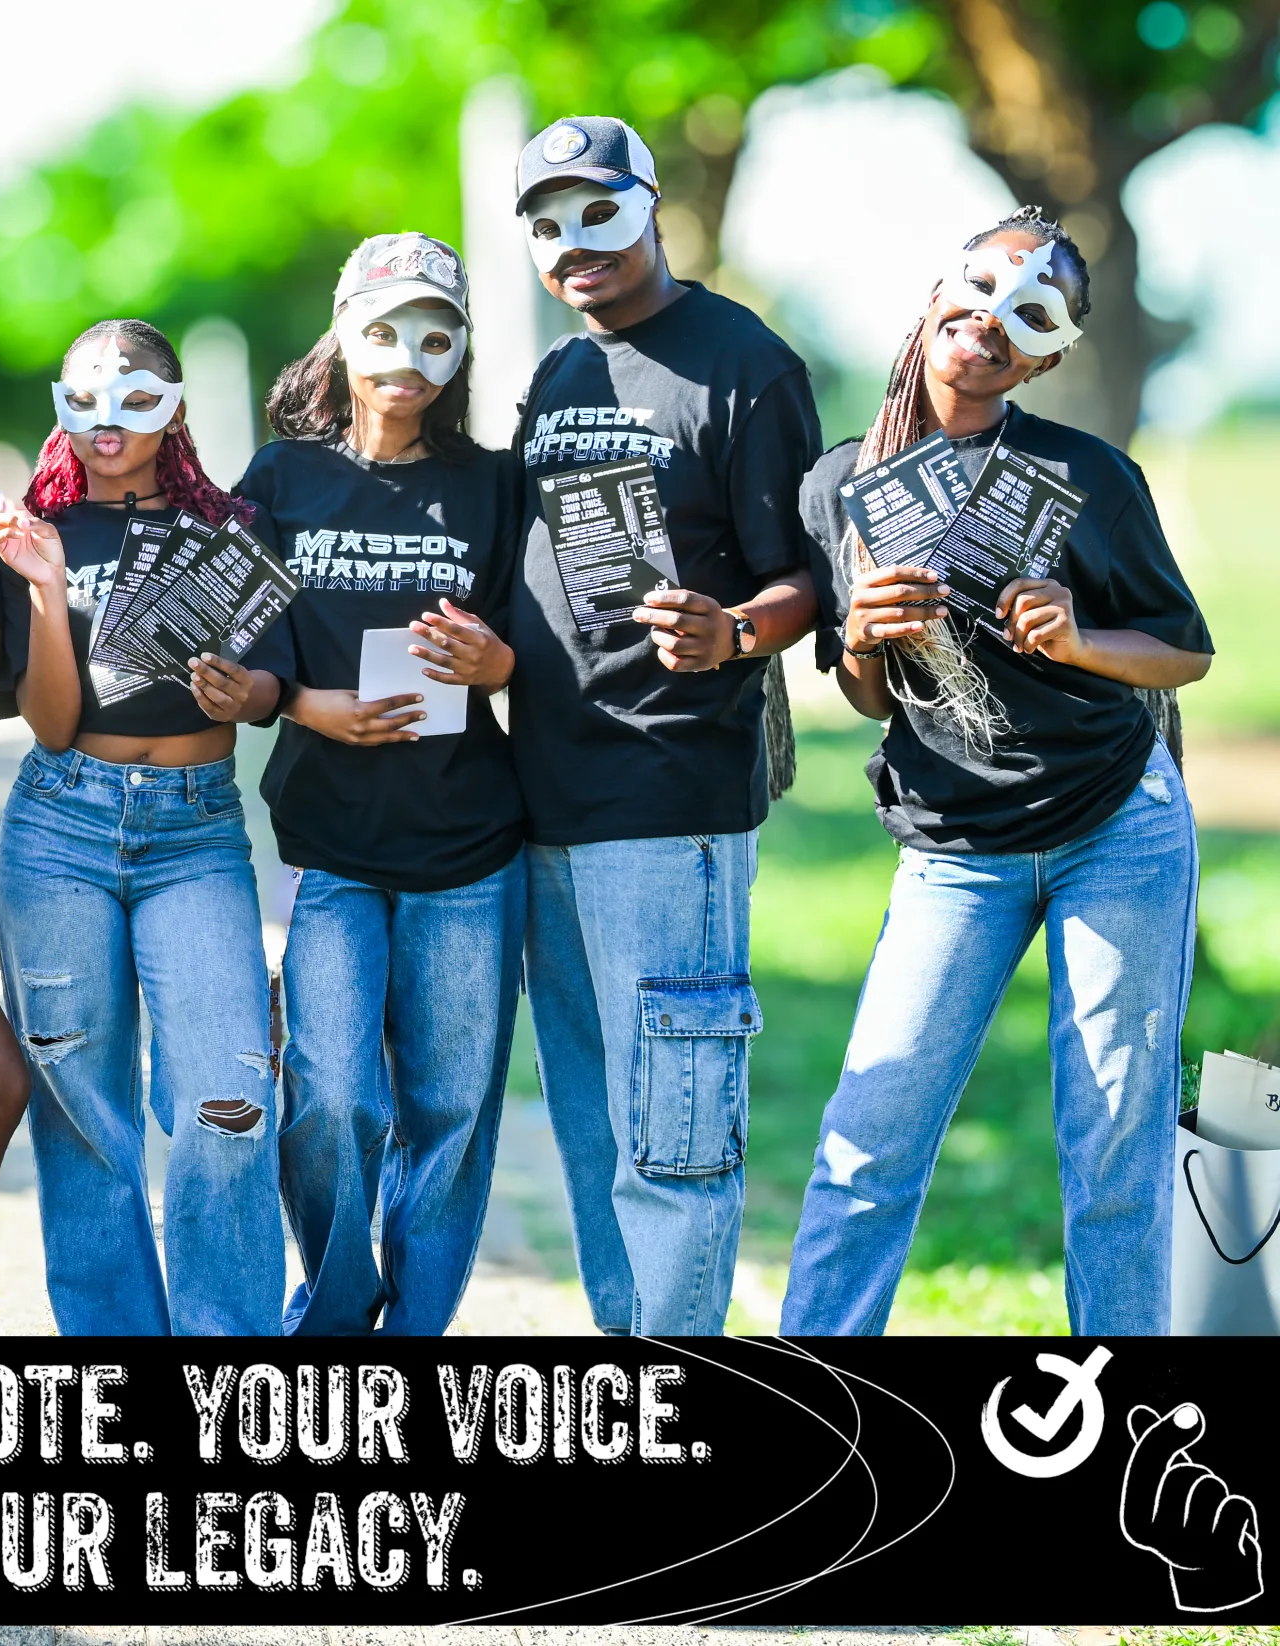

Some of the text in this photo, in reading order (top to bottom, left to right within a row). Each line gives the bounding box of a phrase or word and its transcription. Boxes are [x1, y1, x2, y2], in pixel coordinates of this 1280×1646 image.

[535, 406, 655, 437] MASCOT
[524, 431, 674, 461] SUPPORTER
[560, 488, 601, 504] YOUR VOTE.
[862, 488, 883, 504] YOUR
[881, 478, 903, 493] VOTE.
[995, 478, 1029, 505] YOUR VOICE.
[1001, 470, 1033, 496] YOUR VOTE.
[561, 497, 605, 514] YOUR VOICE.
[865, 486, 909, 513] YOUR VOICE.
[867, 493, 916, 523] YOUR LEGACY.
[988, 486, 1027, 515] YOUR LEGACY.
[560, 506, 610, 524] YOUR LEGACY.
[976, 512, 996, 525] MASCOT
[995, 523, 1024, 542] CHARACTERS
[142, 543, 160, 554] YOUR
[185, 537, 201, 552] YOUR
[294, 529, 469, 559] MASCOT
[567, 538, 589, 547] MASCOT
[590, 531, 625, 542] CHARACTERS
[133, 561, 151, 572] YOUR
[138, 552, 156, 563] YOUR
[172, 553, 189, 568] YOUR
[179, 546, 196, 560] YOUR
[219, 550, 249, 581] YOUR VOICE.
[226, 543, 254, 573] YOUR VOTE.
[210, 555, 244, 590] YOUR LEGACY.
[285, 556, 475, 590] CHAMPION
[187, 569, 234, 614] VUT MASCOT CHARACTERS
